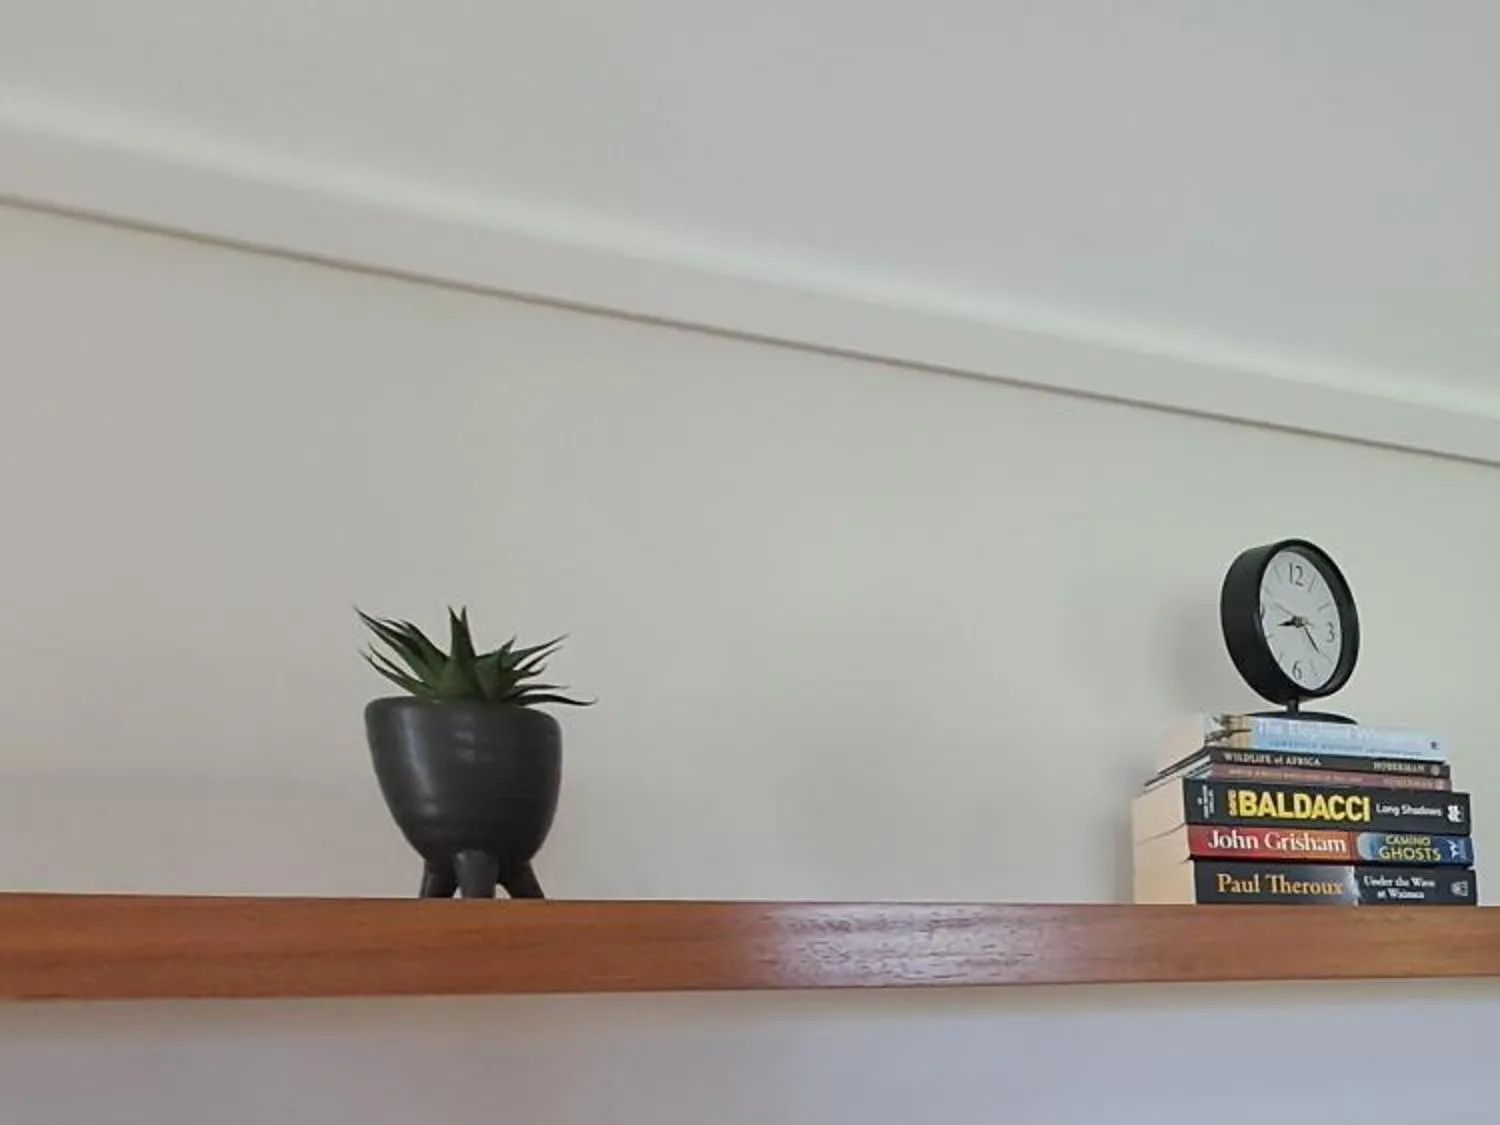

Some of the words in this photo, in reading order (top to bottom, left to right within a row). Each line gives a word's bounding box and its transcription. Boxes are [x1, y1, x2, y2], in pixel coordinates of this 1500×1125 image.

[1289, 562, 1304, 588] 12
[1327, 621, 1336, 644] 3
[1291, 660, 1303, 681] 6
[1224, 753, 1272, 766] WILDLIFE
[1286, 756, 1322, 767] AFRICA
[1237, 789, 1371, 822] BALDACCI
[1375, 803, 1400, 817] Long
[1401, 804, 1443, 817] Shadows
[1207, 829, 1259, 849] John
[1264, 831, 1347, 852] Grisham
[1384, 834, 1431, 846] CAMINO
[1378, 845, 1441, 862] GHOSTS
[1217, 872, 1260, 893] Paul
[1264, 873, 1345, 895] Theroux
[1363, 874, 1393, 887] Under
